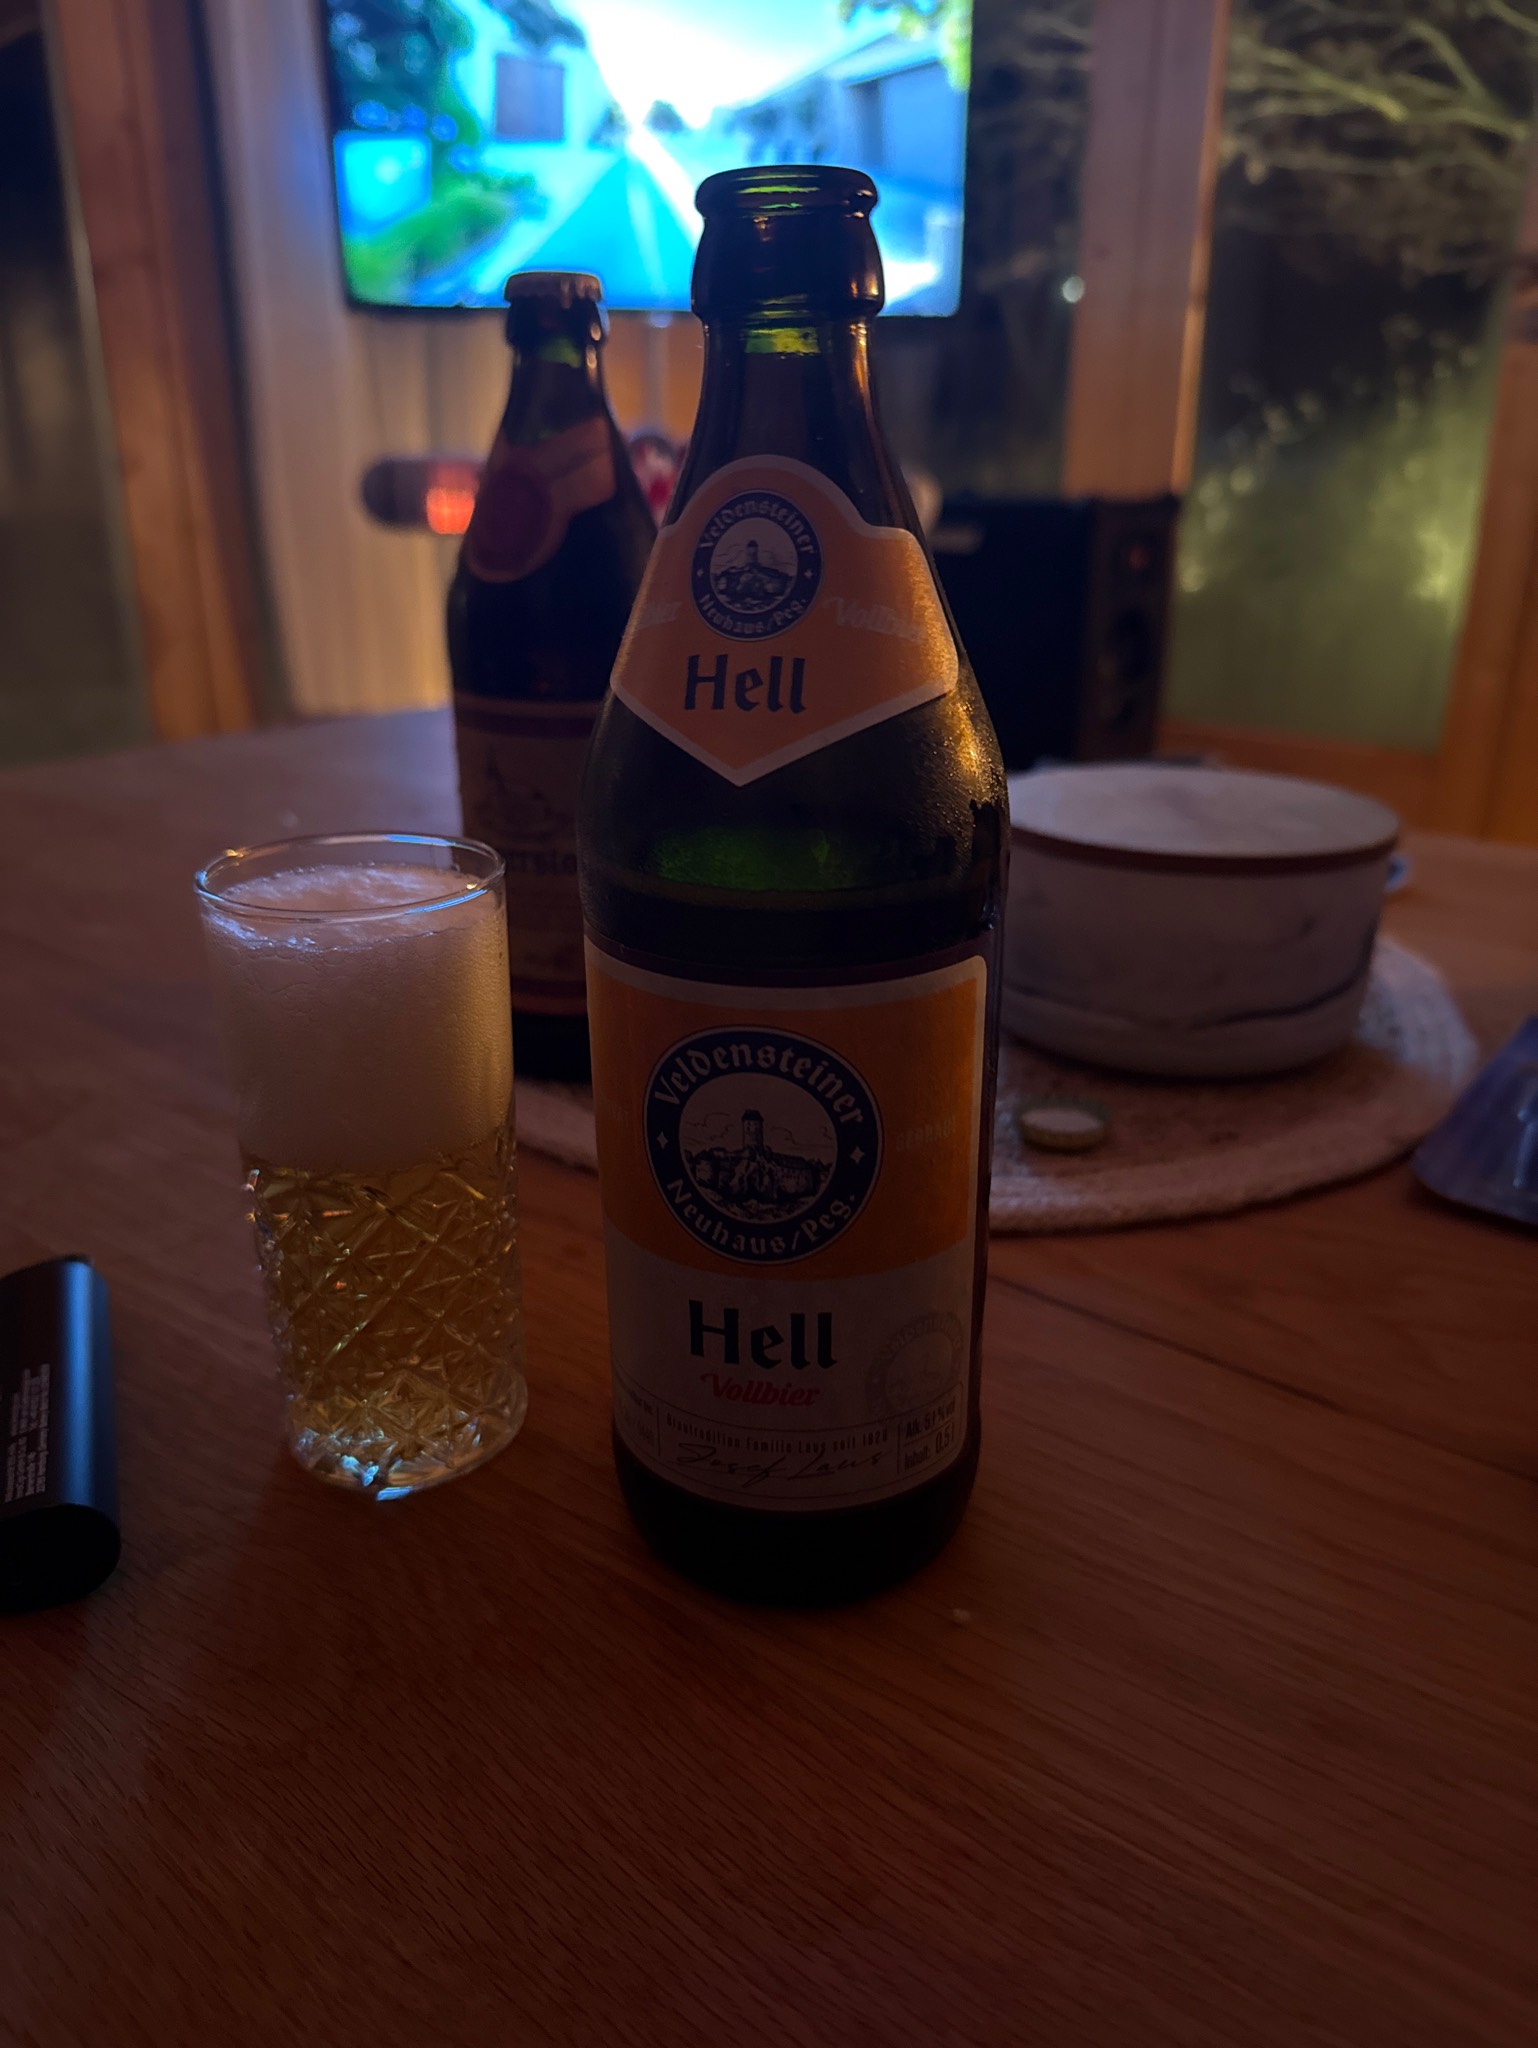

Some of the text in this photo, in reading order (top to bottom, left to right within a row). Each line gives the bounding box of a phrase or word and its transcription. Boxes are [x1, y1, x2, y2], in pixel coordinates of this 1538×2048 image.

[699, 499, 817, 556] Veldensteiner
[684, 654, 807, 715] Hell
[653, 1041, 865, 1126] Veldensteiner
[667, 1176, 857, 1256] Neuhaus/Peg.
[688, 1299, 838, 1370] Hell
[701, 1372, 820, 1406] Vollbier
[746, 1436, 792, 1454] Familie
[833, 1433, 857, 1453] seit
